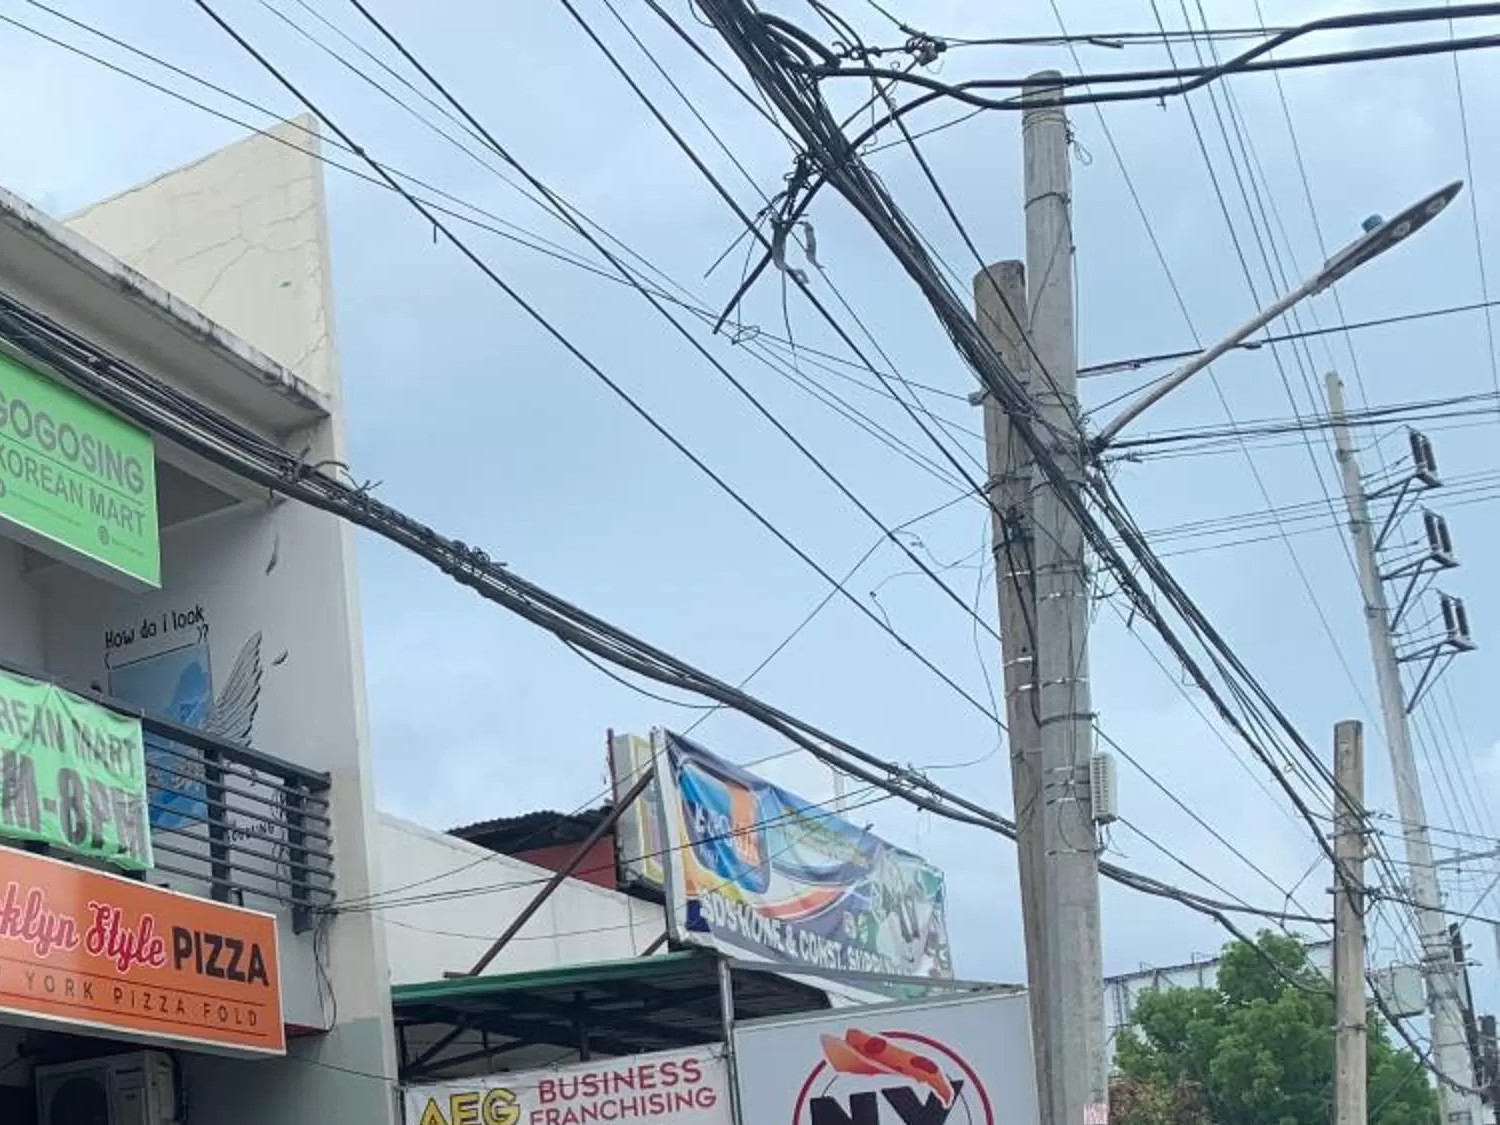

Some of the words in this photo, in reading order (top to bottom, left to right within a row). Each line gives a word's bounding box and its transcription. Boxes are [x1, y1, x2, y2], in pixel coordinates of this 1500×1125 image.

[89, 492, 146, 537] MART
[104, 629, 135, 650] How
[140, 618, 157, 640] do
[173, 604, 205, 630] look
[71, 717, 138, 786] MART
[86, 900, 166, 974] Style
[171, 926, 270, 987] PIZZA
[25, 970, 96, 1001] YORK
[112, 987, 186, 1016] PIZZA
[201, 1002, 259, 1028] FOLD
[537, 1057, 703, 1105] BUSINESS
